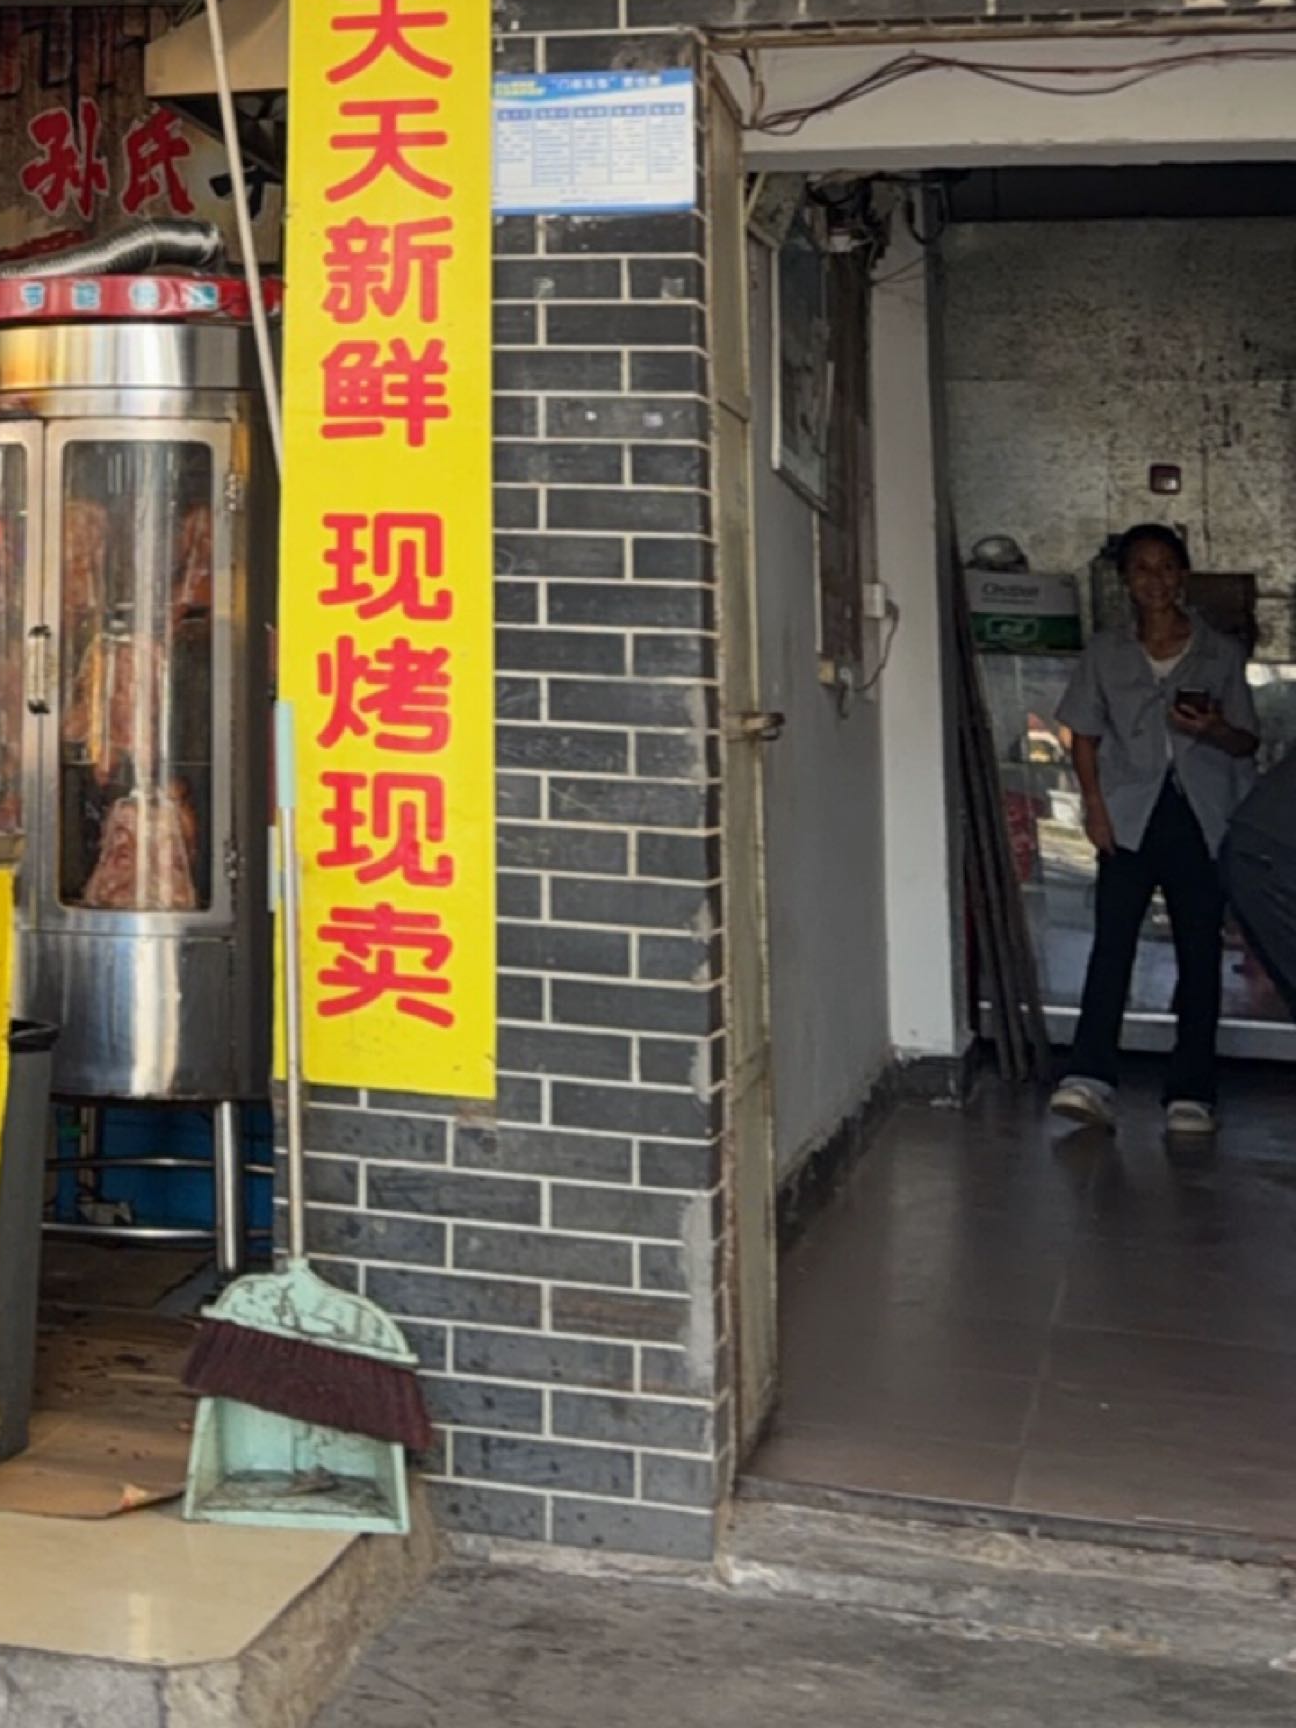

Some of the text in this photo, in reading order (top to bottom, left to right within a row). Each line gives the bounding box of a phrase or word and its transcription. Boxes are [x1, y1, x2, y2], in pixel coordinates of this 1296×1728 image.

[20, 95, 196, 221] 孙氏
[317, 512, 455, 1028] 现烤现卖
